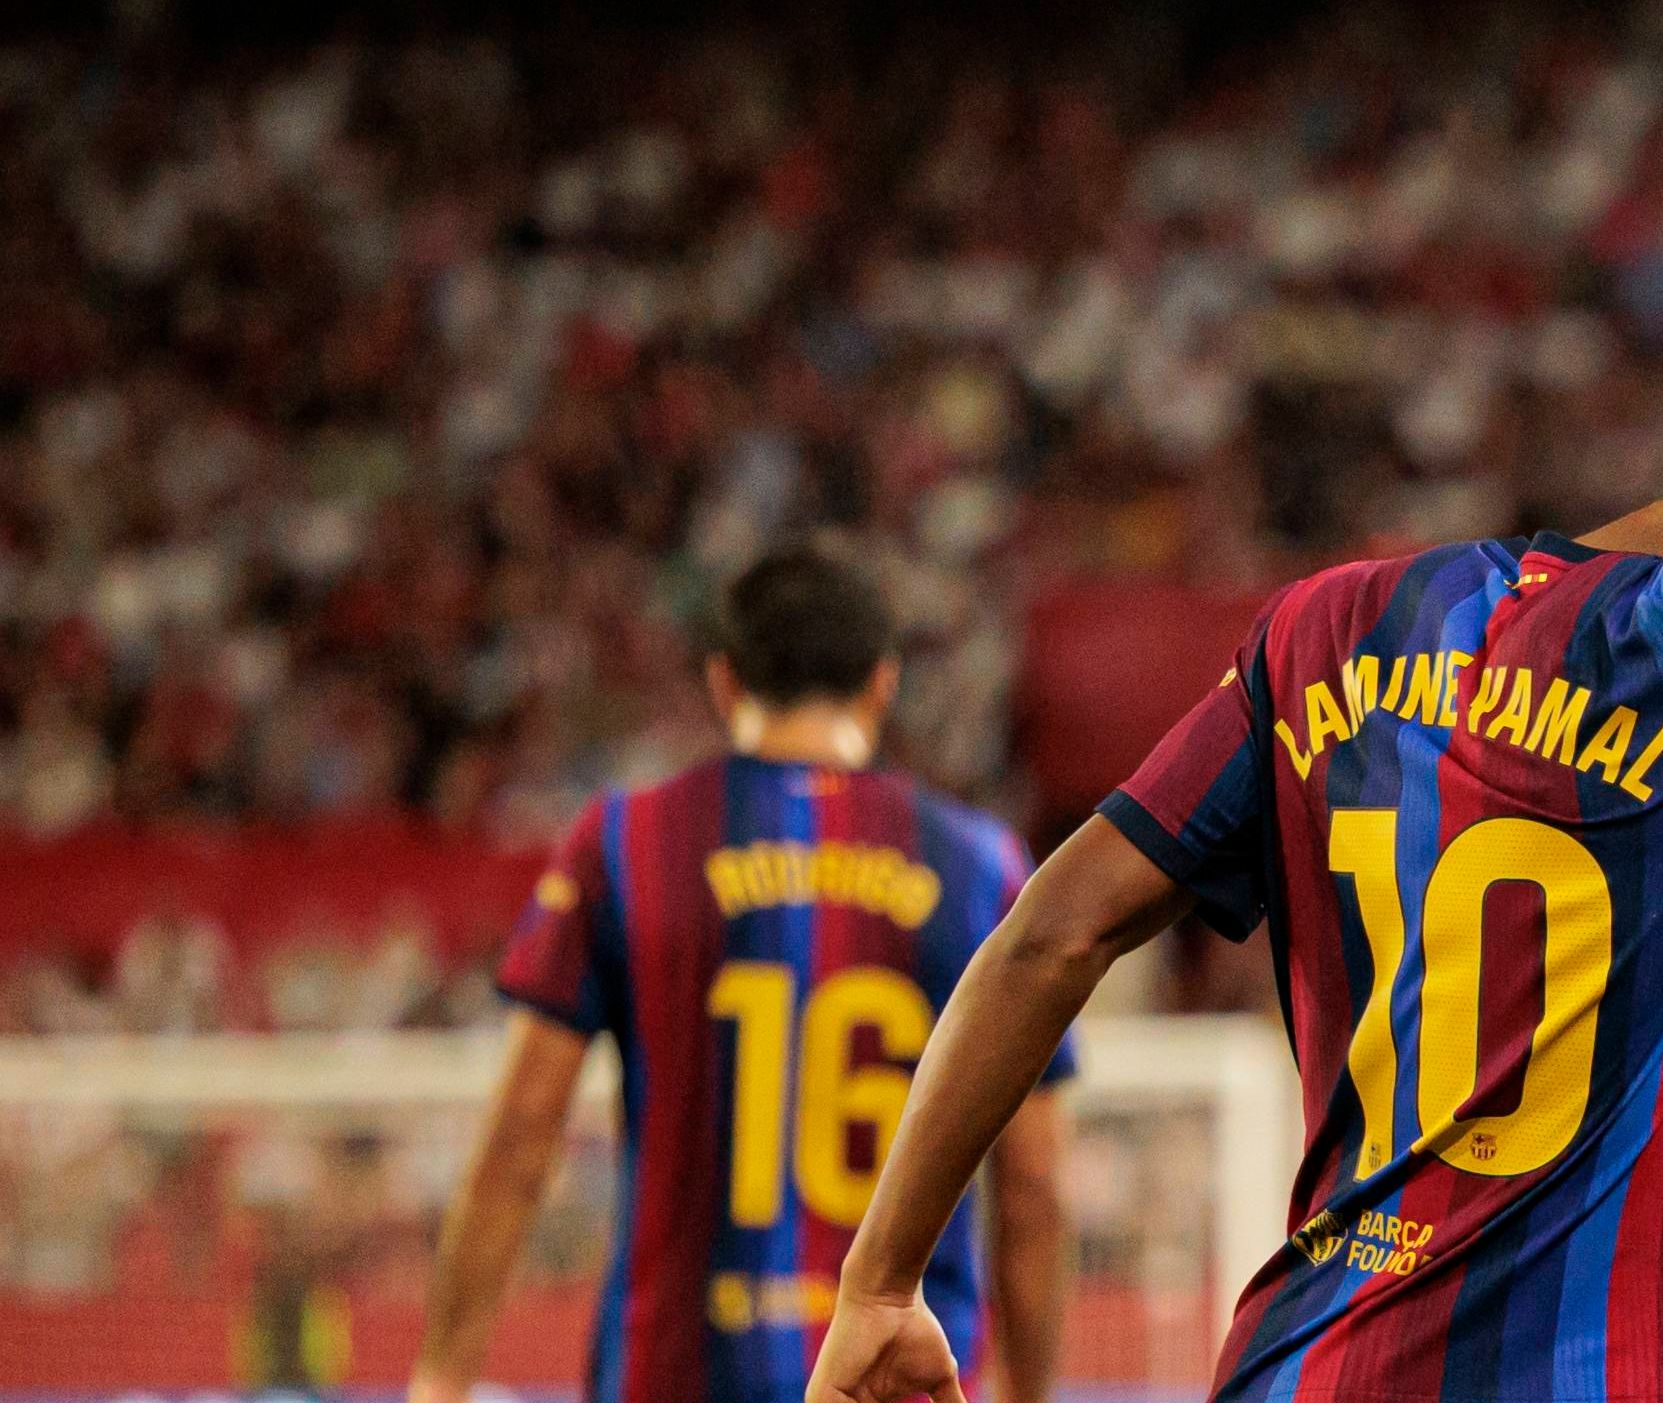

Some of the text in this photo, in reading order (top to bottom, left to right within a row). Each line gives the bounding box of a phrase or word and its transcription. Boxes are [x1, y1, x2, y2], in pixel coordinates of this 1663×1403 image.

[1275, 650, 1474, 781] LAMINE
[1329, 809, 1611, 1181] 10
[709, 961, 936, 1229] 16
[1357, 1210, 1433, 1251] BARÇA
